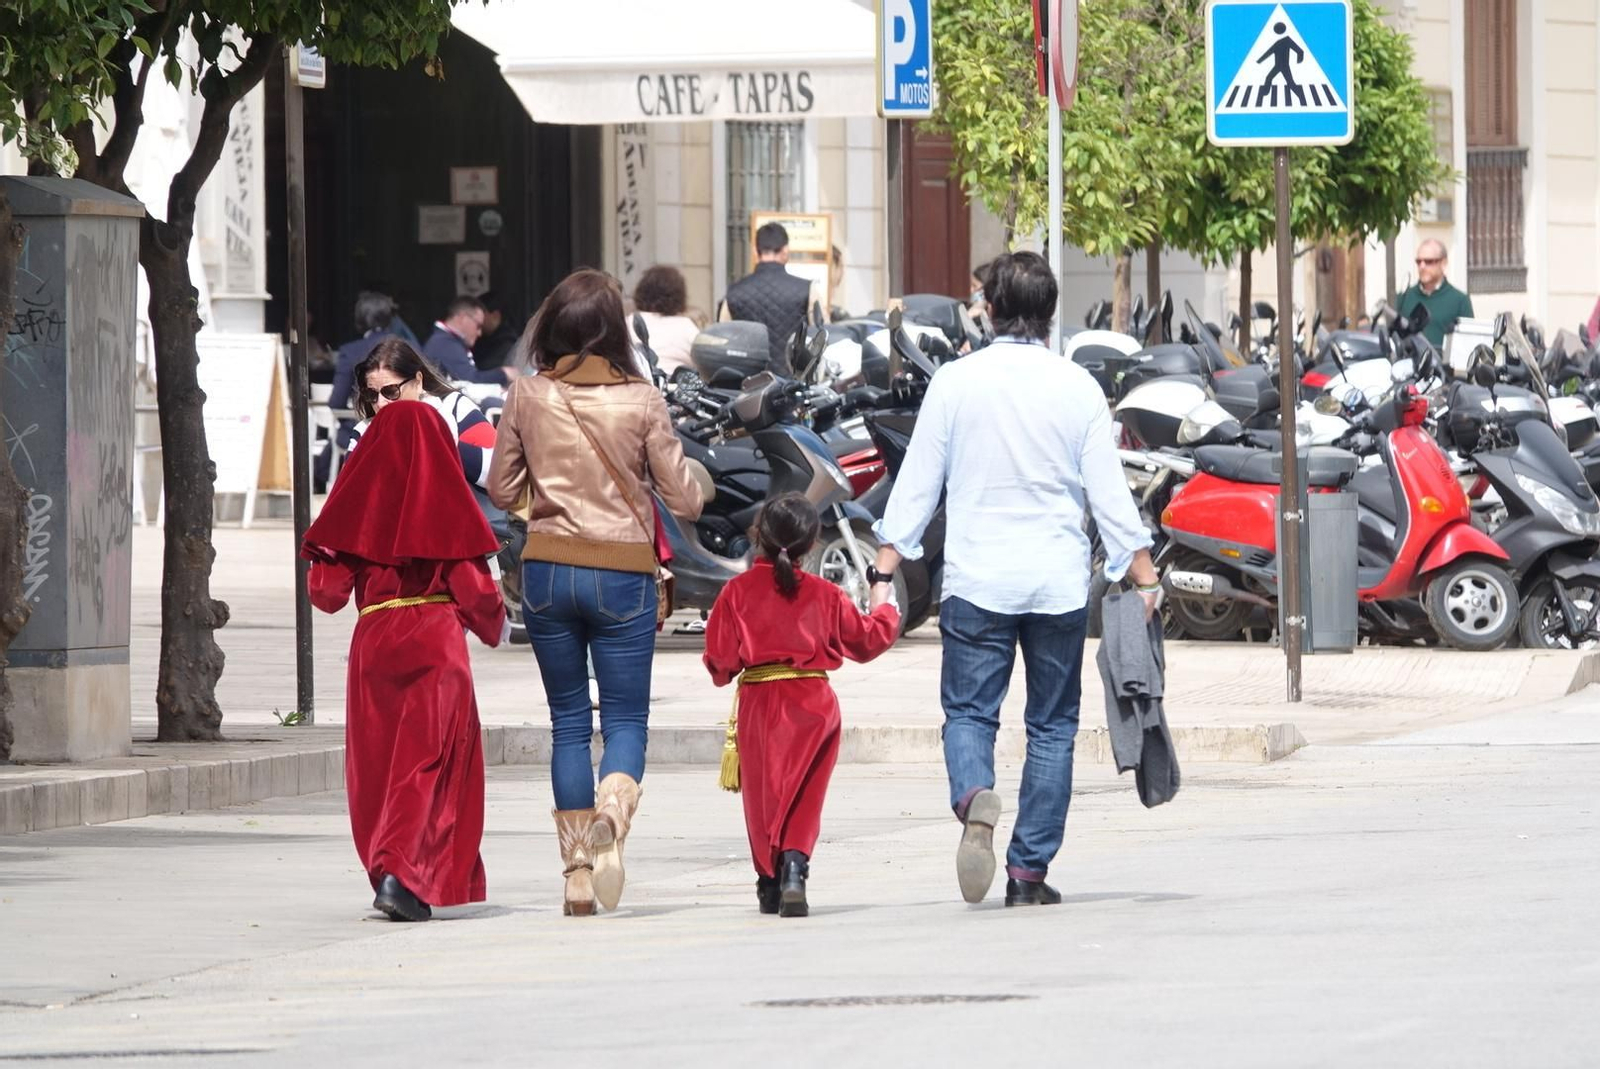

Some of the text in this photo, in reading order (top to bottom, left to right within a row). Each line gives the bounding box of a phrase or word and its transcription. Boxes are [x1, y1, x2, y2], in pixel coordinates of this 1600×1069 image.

[884, 0, 916, 101] P
[637, 71, 815, 116] CAFE TAPAS
[900, 82, 929, 104] MOTOS
